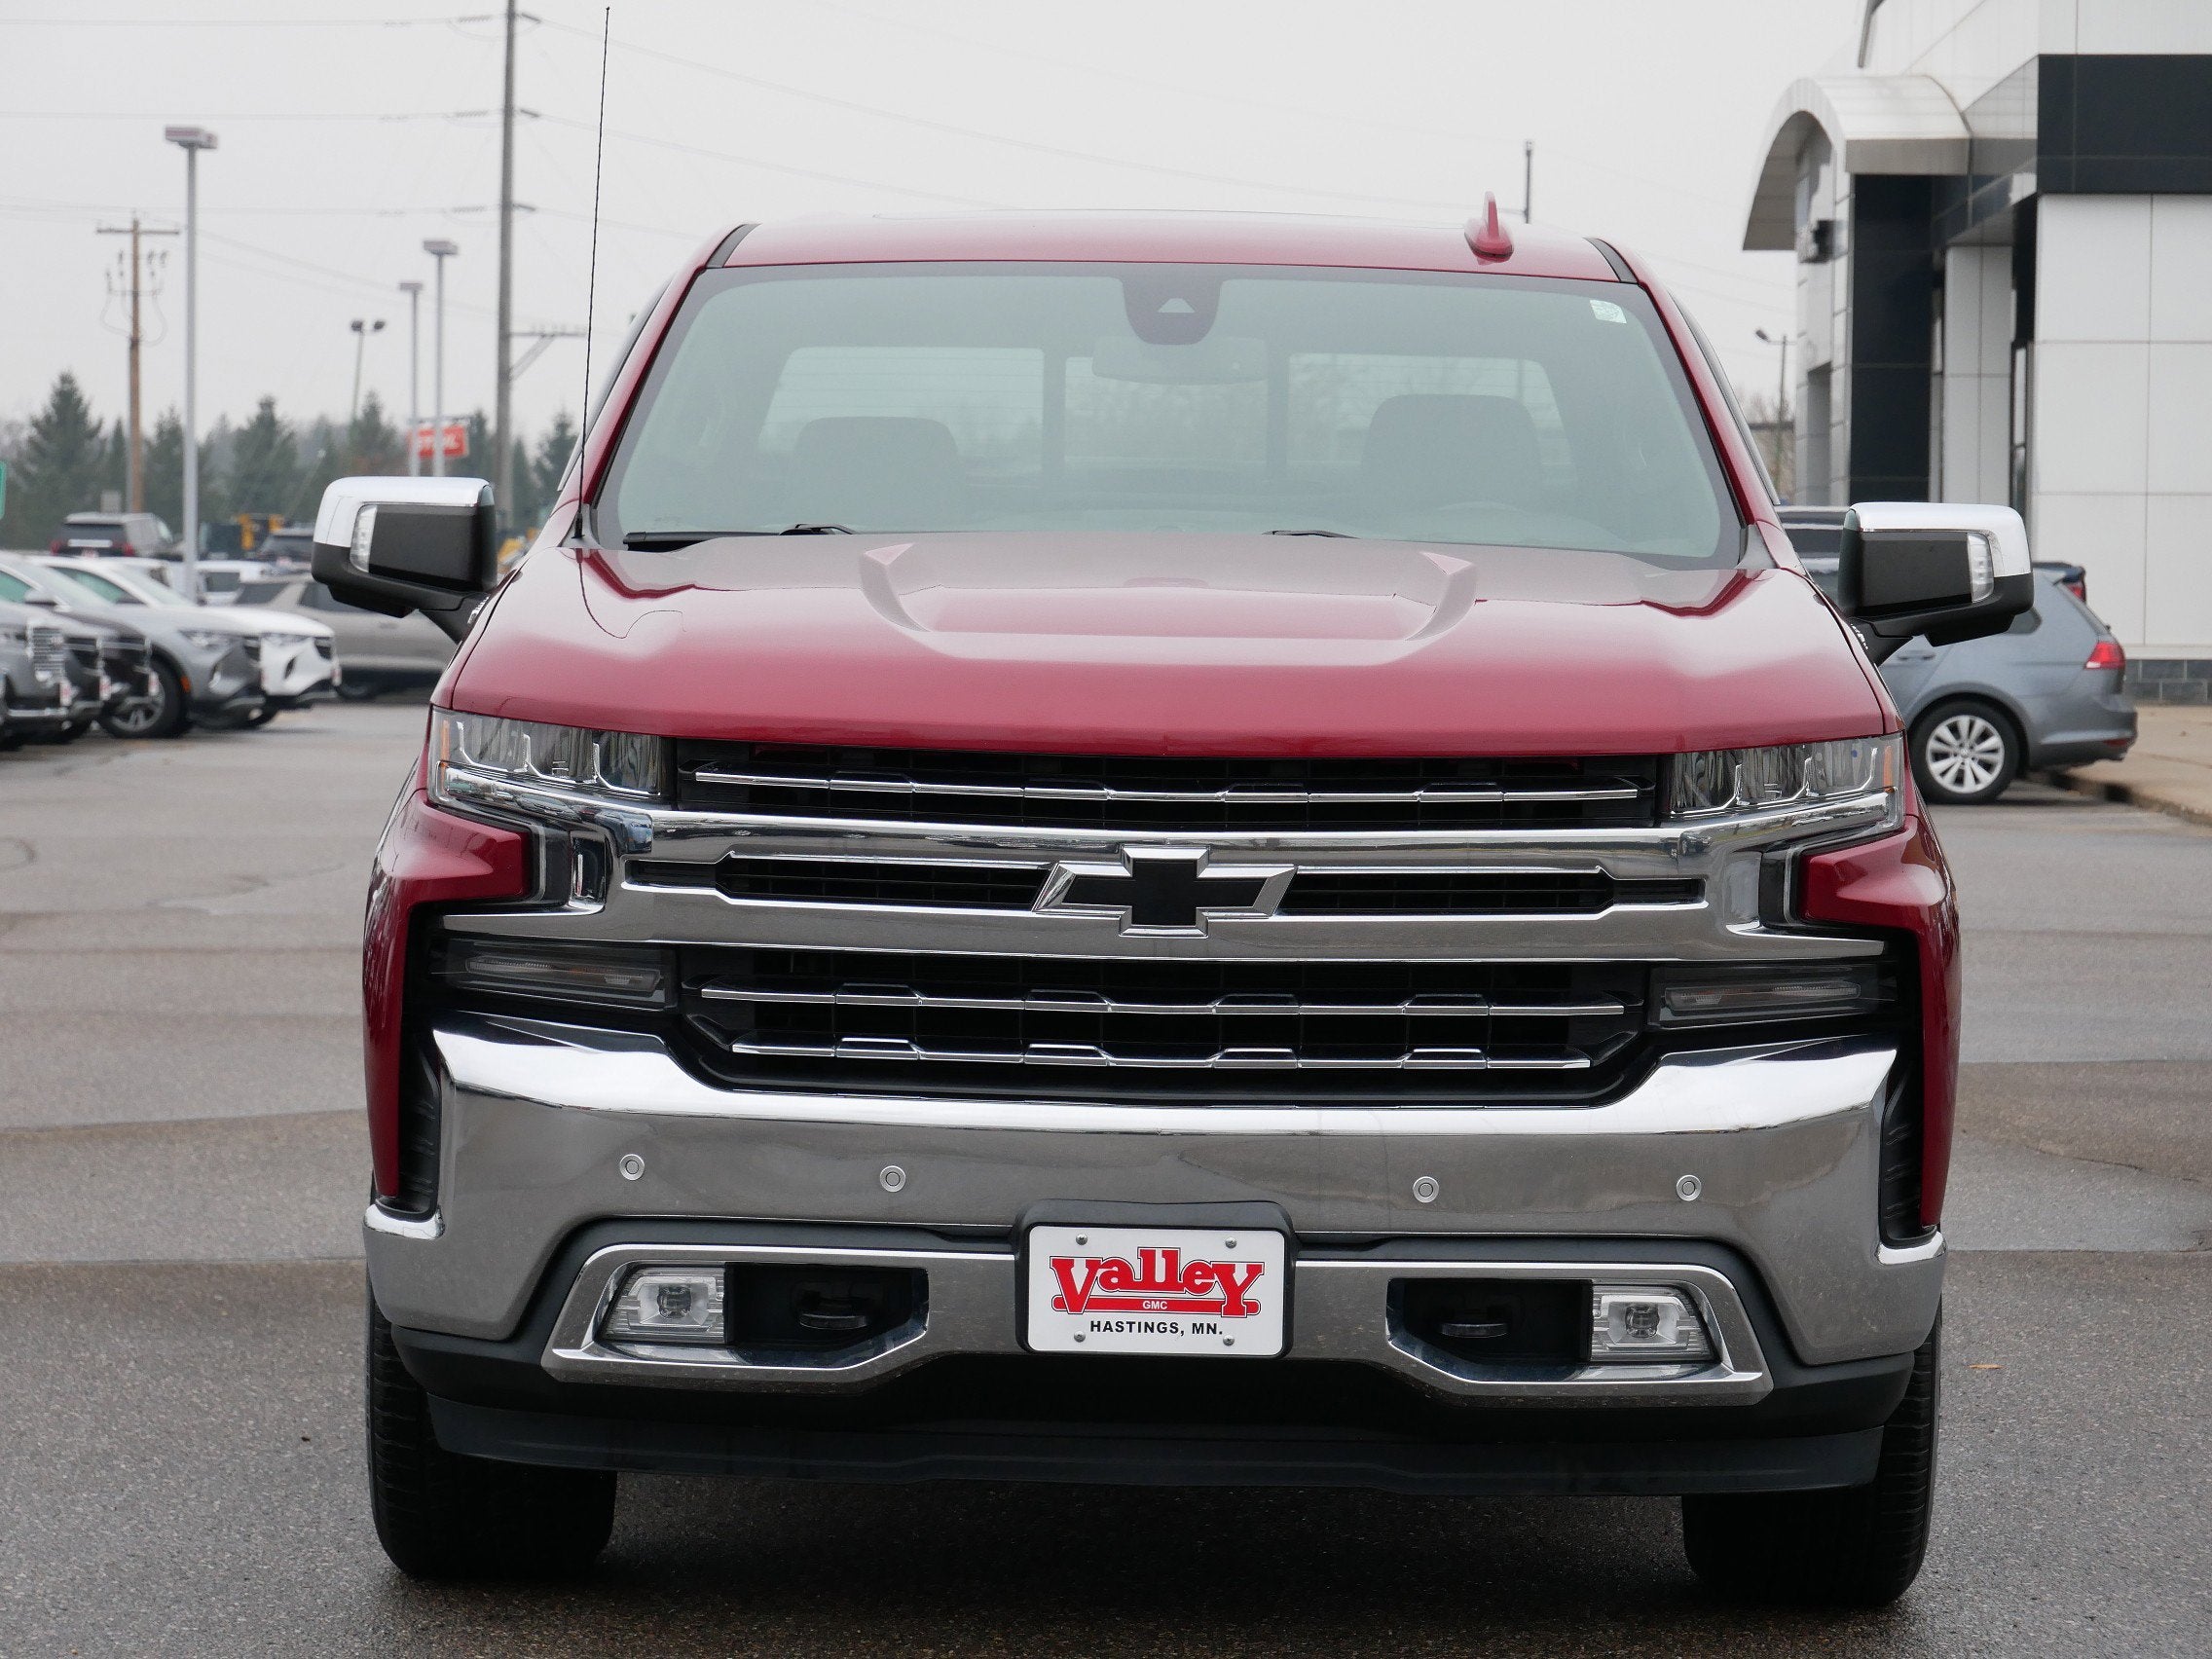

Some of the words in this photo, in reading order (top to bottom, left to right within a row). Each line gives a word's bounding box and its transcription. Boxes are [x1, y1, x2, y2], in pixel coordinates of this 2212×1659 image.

[1142, 1300, 1168, 1310] GMC
[1089, 1320, 1185, 1337] HASTINGS,
[1192, 1322, 1223, 1336] MN.
